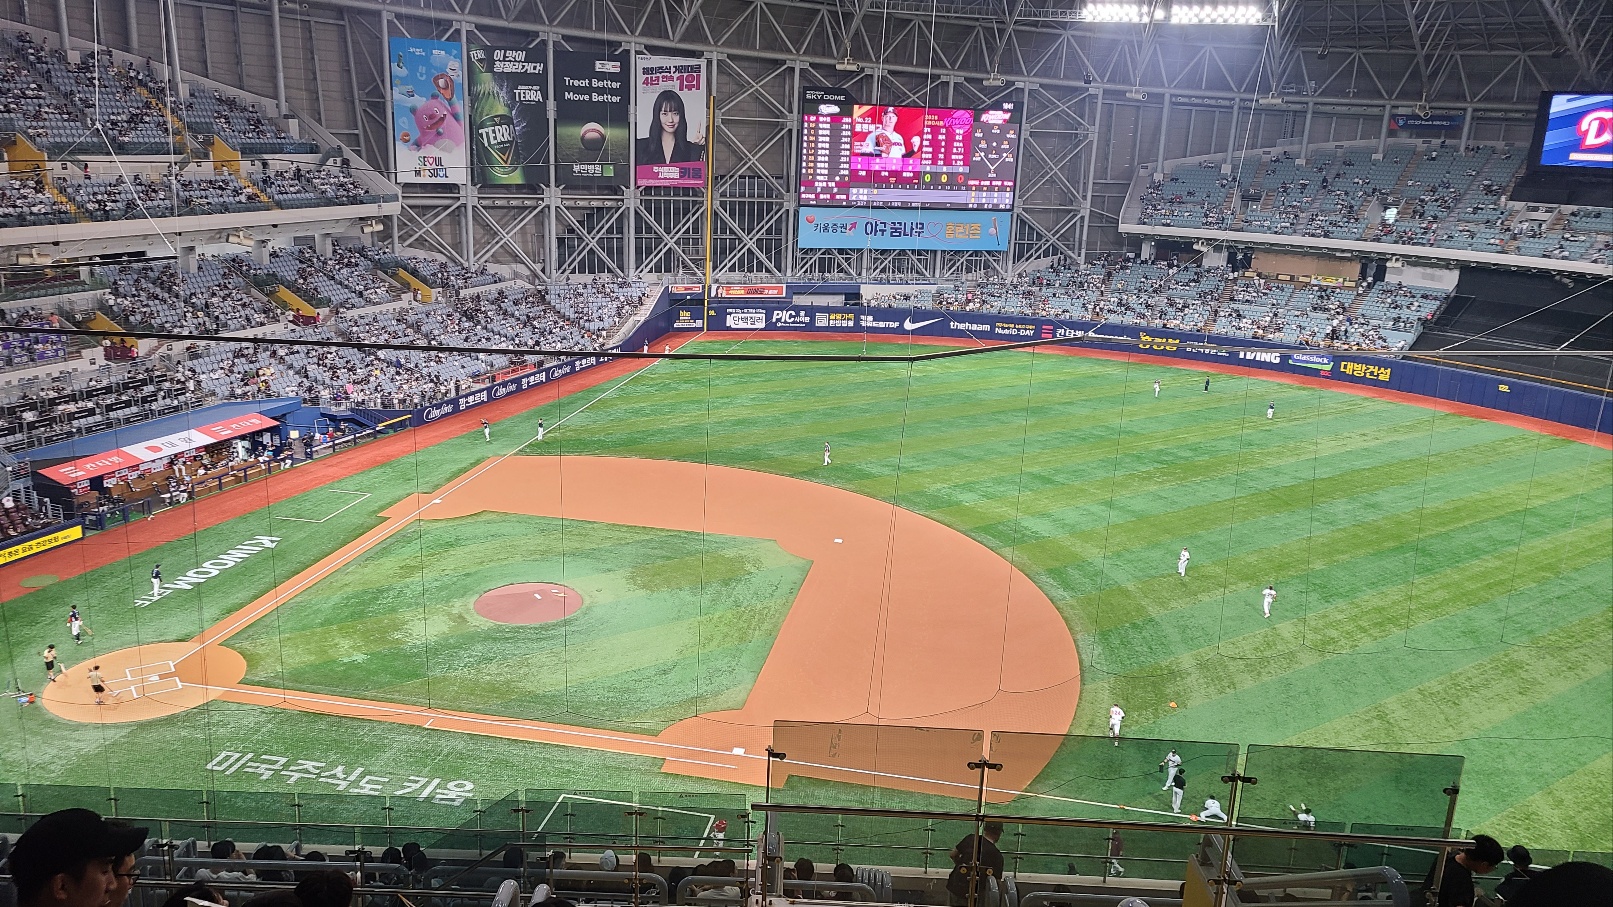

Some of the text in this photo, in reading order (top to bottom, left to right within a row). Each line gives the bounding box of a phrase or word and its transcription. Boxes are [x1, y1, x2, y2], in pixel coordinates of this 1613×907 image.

[494, 50, 526, 62] 이 맛이
[494, 61, 544, 74] 청정라거다!
[642, 64, 702, 76] 해외주식 거래대금
[564, 76, 622, 89] Treat Better
[642, 76, 660, 86] 4년
[661, 74, 674, 82] 연속
[676, 74, 701, 92] 1위
[514, 90, 543, 102] TERRA
[564, 92, 622, 103] Move Better
[478, 124, 516, 147] TERRA
[572, 164, 602, 174] 부민병원
[924, 174, 931, 182] 0
[941, 174, 948, 183] 0
[813, 220, 982, 239] 키움증권 야구 꿈나무 홈런존
[772, 310, 796, 322] PIC
[950, 321, 990, 332] thehaam
[1294, 354, 1329, 364] Glasslock
[1340, 362, 1392, 382] 대방건설
[162, 534, 283, 590] KIWOOM
[206, 750, 474, 806] 미국주식도 키움
